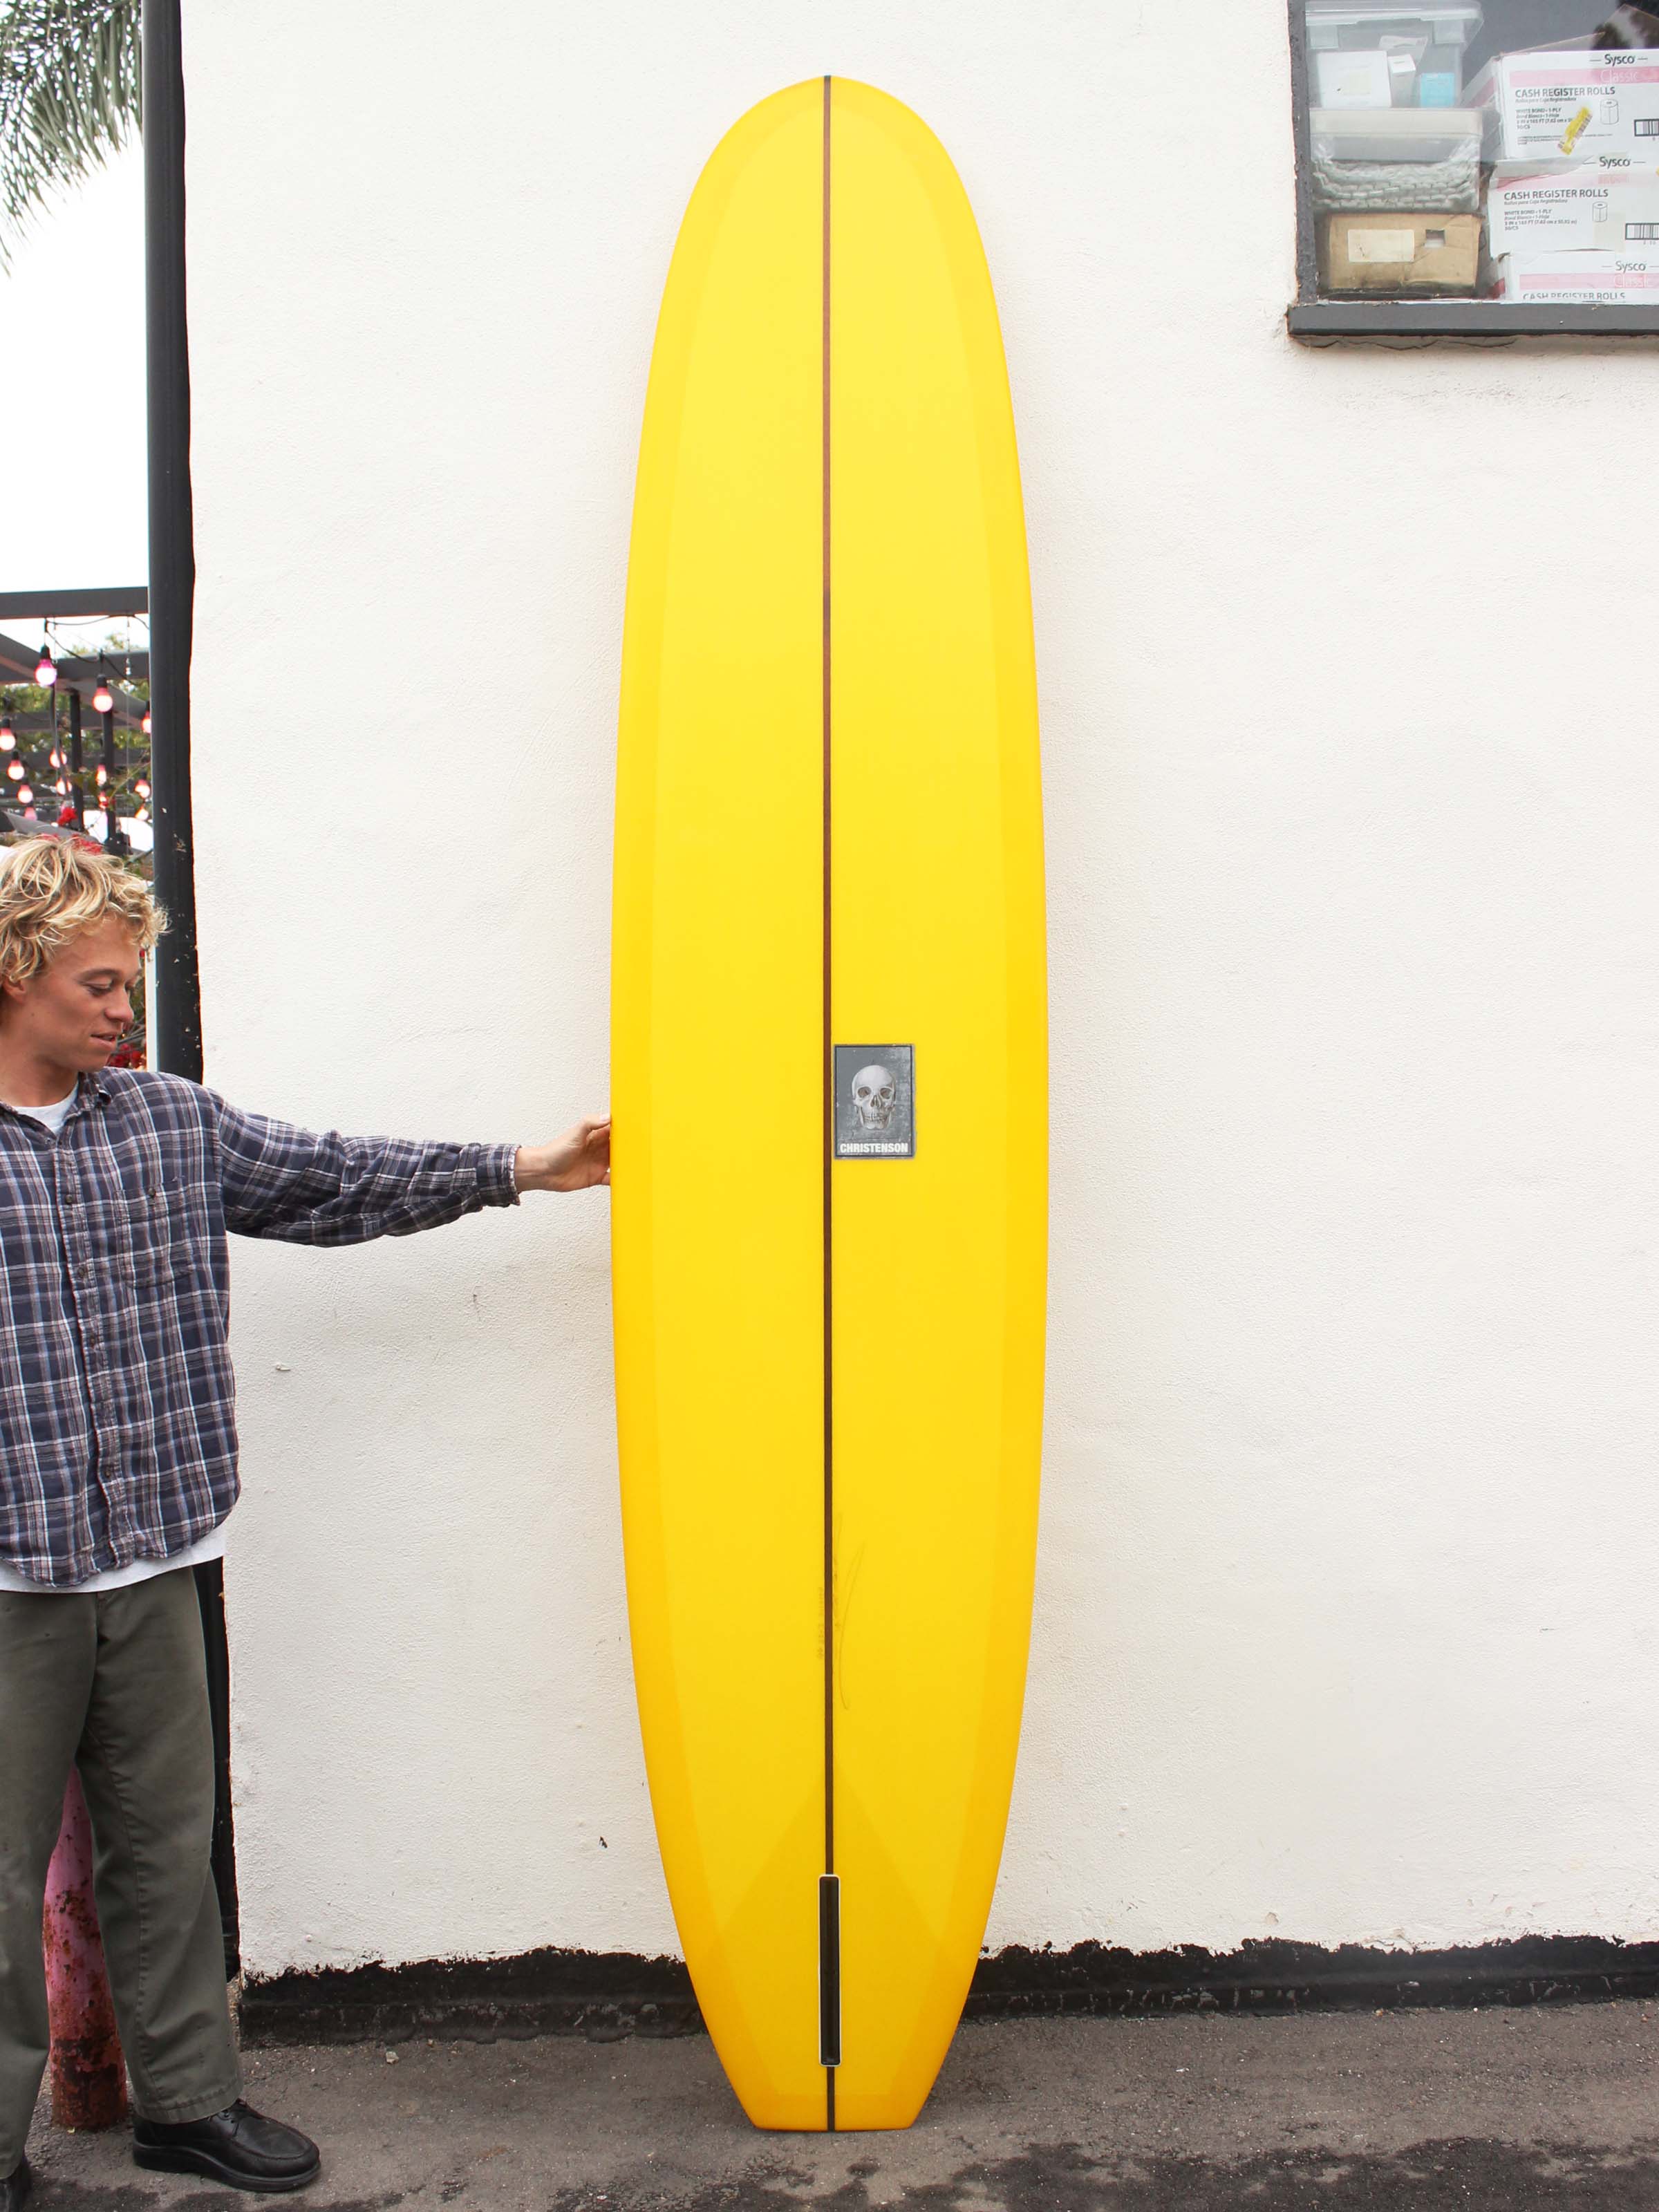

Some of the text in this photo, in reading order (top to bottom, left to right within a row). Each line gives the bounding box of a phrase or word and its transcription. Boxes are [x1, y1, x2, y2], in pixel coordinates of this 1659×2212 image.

[1604, 53, 1635, 66] Sysco
[1600, 69, 1638, 83] Classic
[1515, 86, 1615, 98] CASH REGISTER ROLLS
[1600, 156, 1631, 169] Sysco
[1504, 189, 1609, 200] CASH REGISTER ROLLS
[1615, 261, 1646, 274] Sysco
[1597, 292, 1626, 300] ROLLS
[840, 1143, 908, 1153] CHRISTENSON
